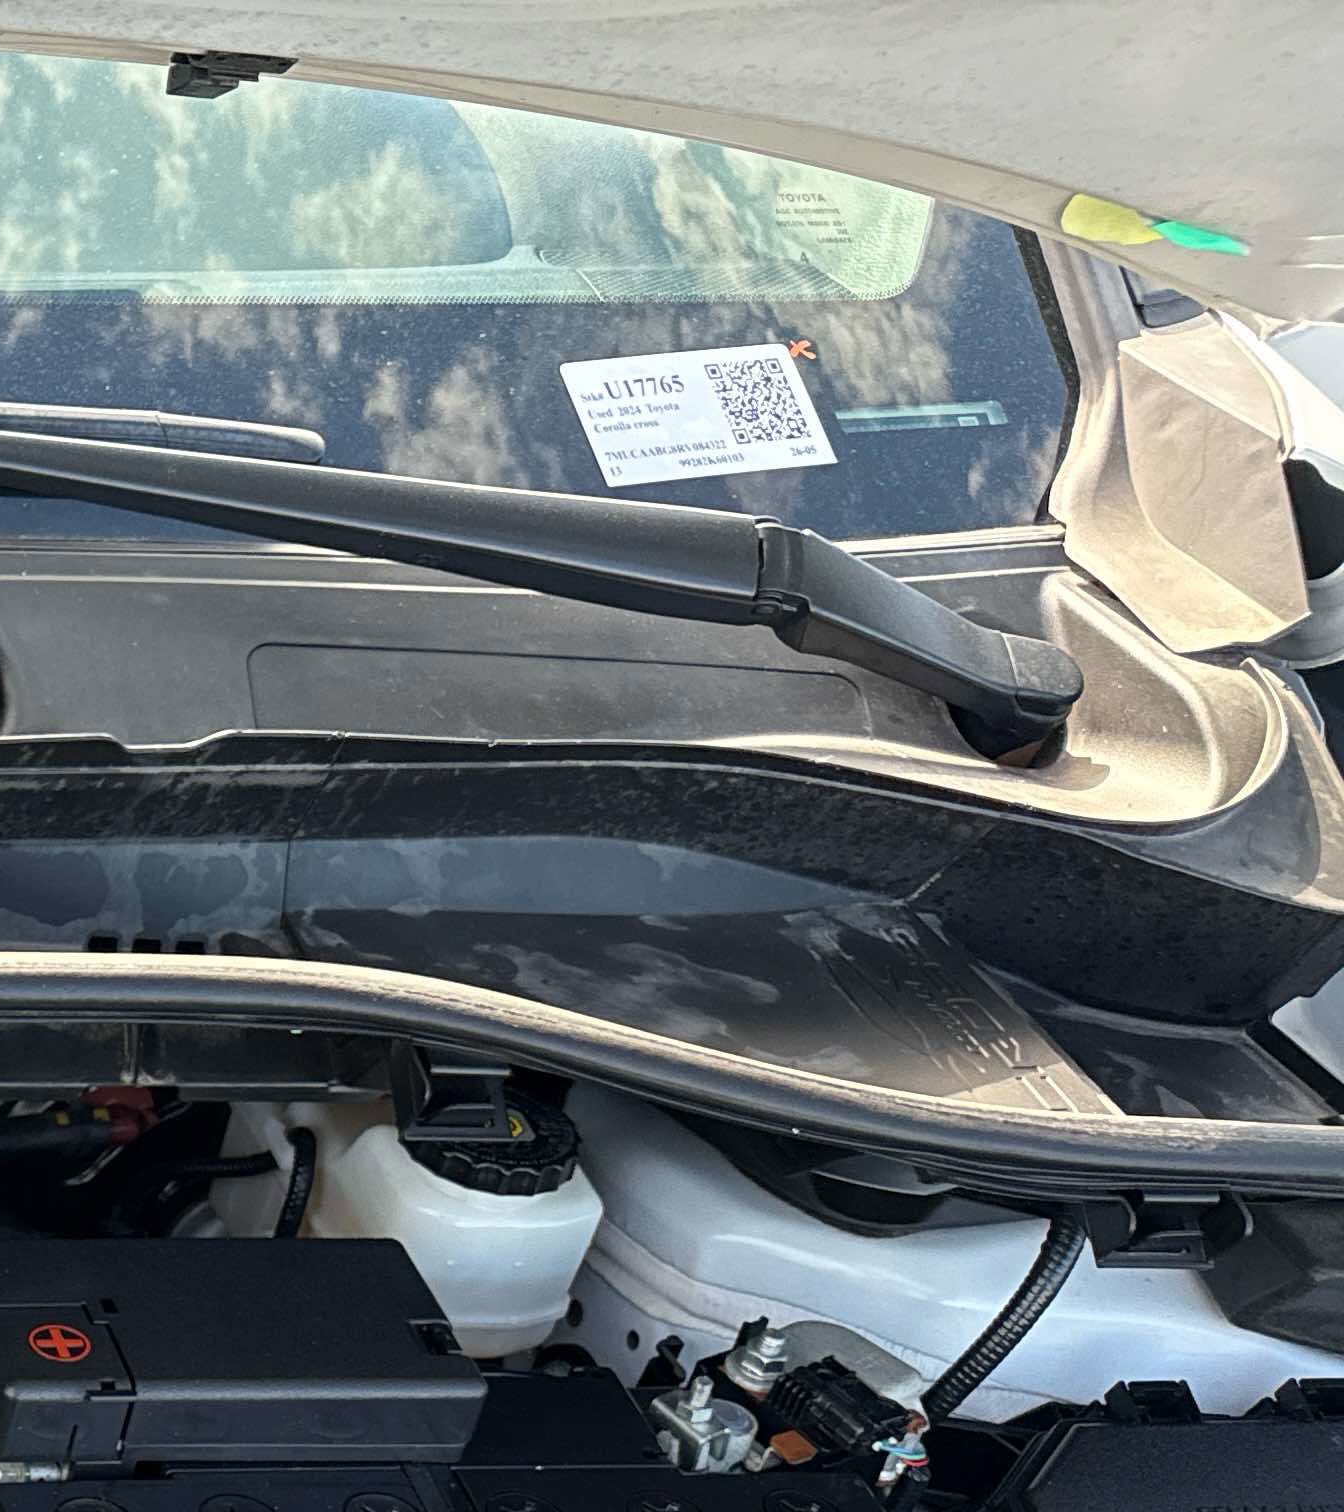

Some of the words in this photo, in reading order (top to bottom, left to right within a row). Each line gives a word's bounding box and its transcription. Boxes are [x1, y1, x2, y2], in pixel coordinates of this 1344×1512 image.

[777, 193, 827, 203] TOYOTA
[604, 375, 684, 399] U17765
[588, 408, 612, 418] Used
[646, 401, 680, 414] Toyota
[593, 421, 631, 433] Corolla
